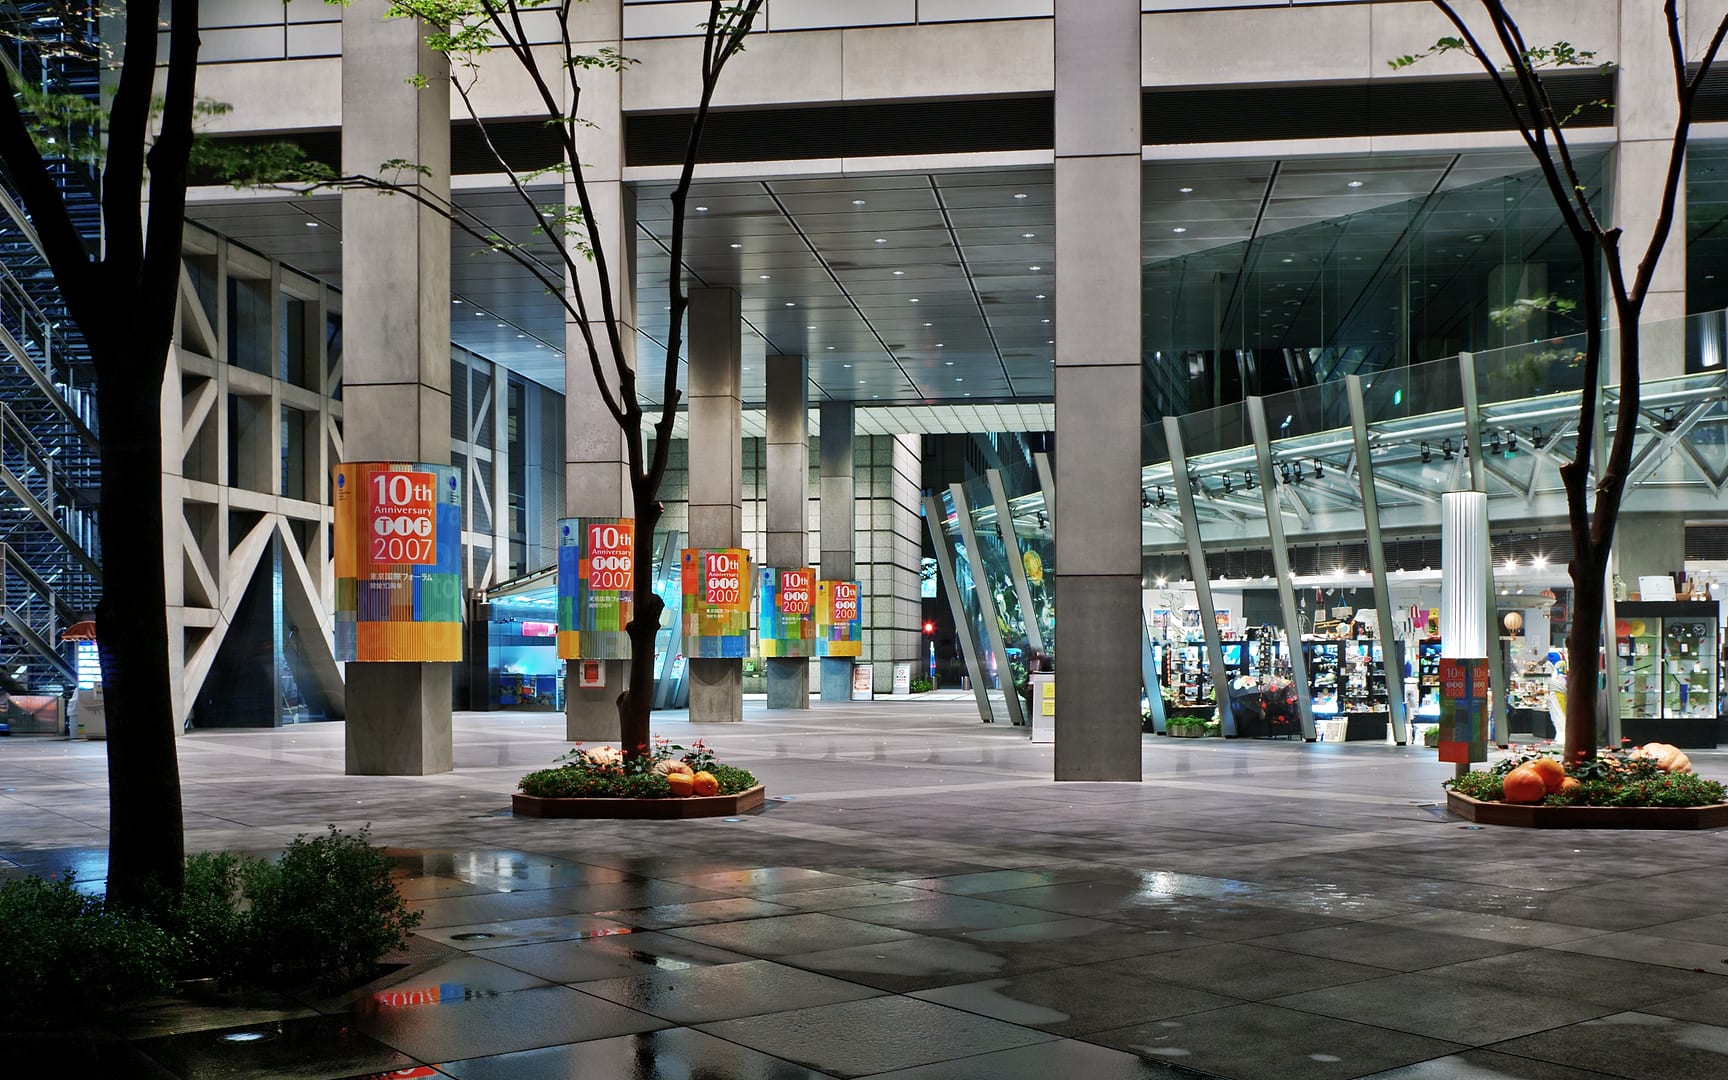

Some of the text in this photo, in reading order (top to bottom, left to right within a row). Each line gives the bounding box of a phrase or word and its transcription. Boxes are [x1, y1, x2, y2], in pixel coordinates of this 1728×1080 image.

[373, 475, 432, 505] 10th
[374, 506, 432, 516] Anniversary
[376, 517, 431, 535] TIF
[591, 527, 631, 549] 10th
[373, 538, 432, 561] 2007
[592, 549, 631, 557] Anniversary
[593, 557, 631, 570] TIF
[708, 555, 739, 571] 10th
[592, 572, 632, 588] 2007
[784, 573, 809, 588] 10th
[708, 590, 739, 603] 2007
[835, 586, 856, 598] 10th
[783, 601, 809, 612] 2007
[835, 609, 856, 619] 2007
